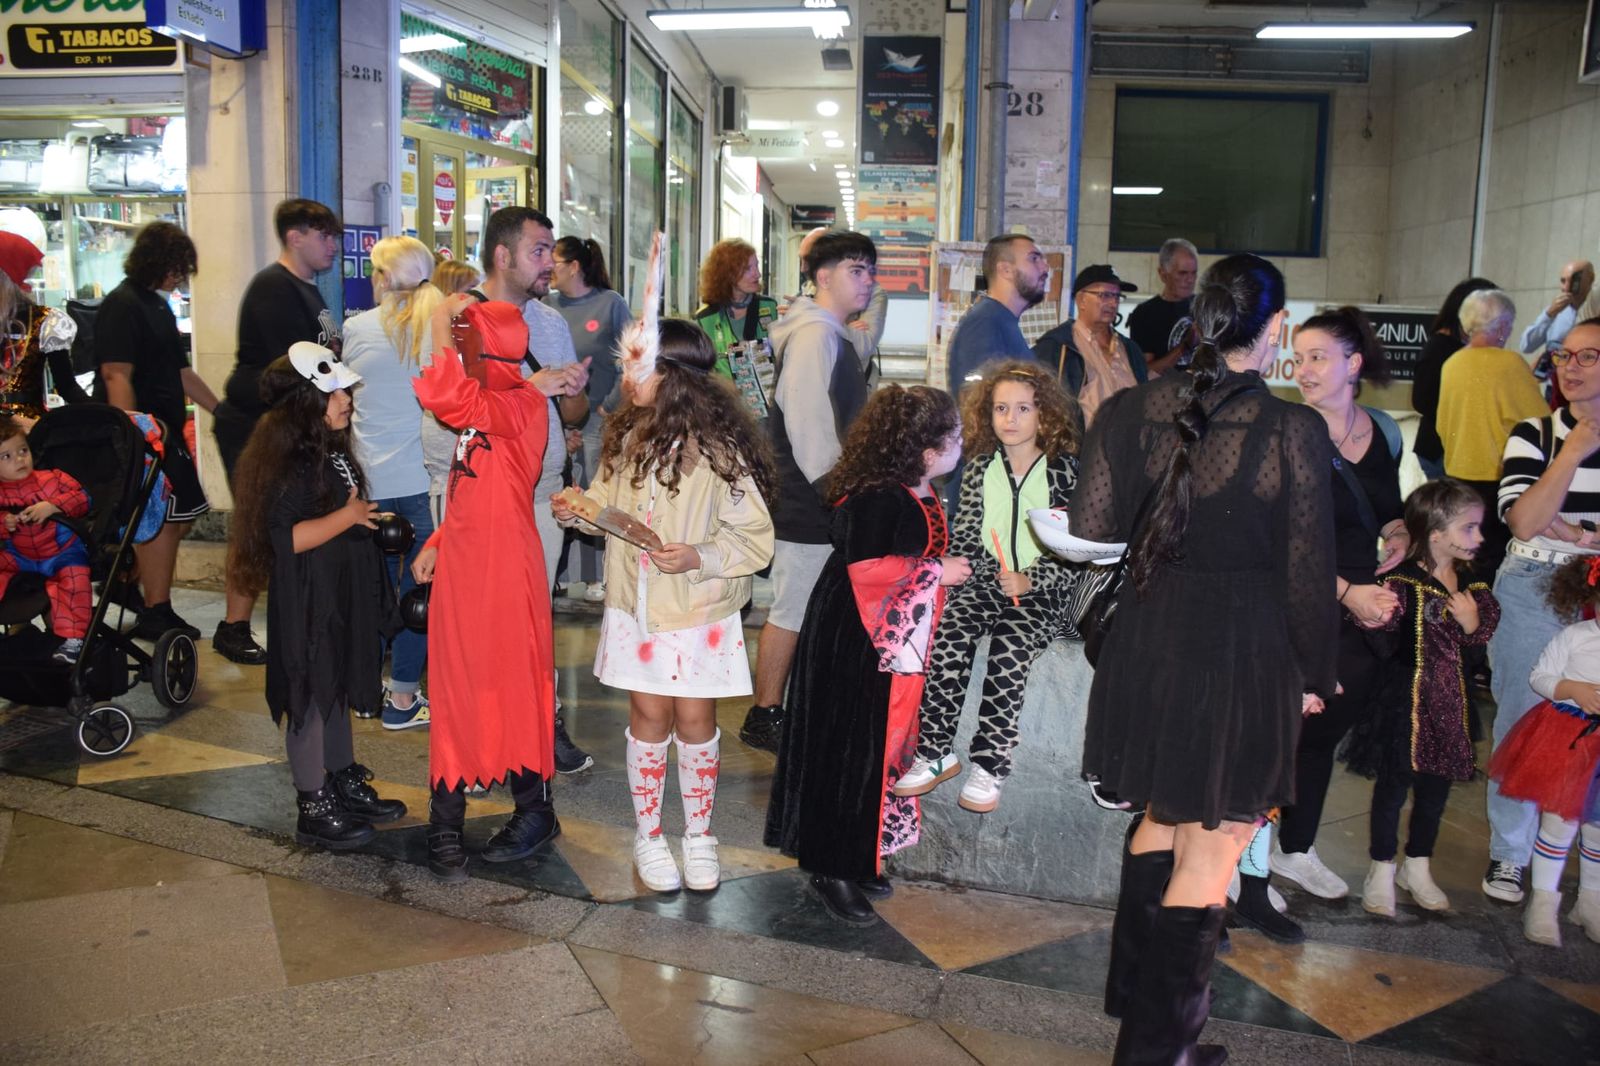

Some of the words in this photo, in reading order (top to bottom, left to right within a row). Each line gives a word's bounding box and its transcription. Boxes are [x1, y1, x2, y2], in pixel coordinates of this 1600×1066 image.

[177, 5, 205, 27] Estado
[60, 28, 153, 47] TABACOS
[74, 56, 93, 64] EXP.
[470, 74, 500, 94] REAL
[457, 88, 493, 109] TABACOS
[1007, 91, 1044, 117] 28
